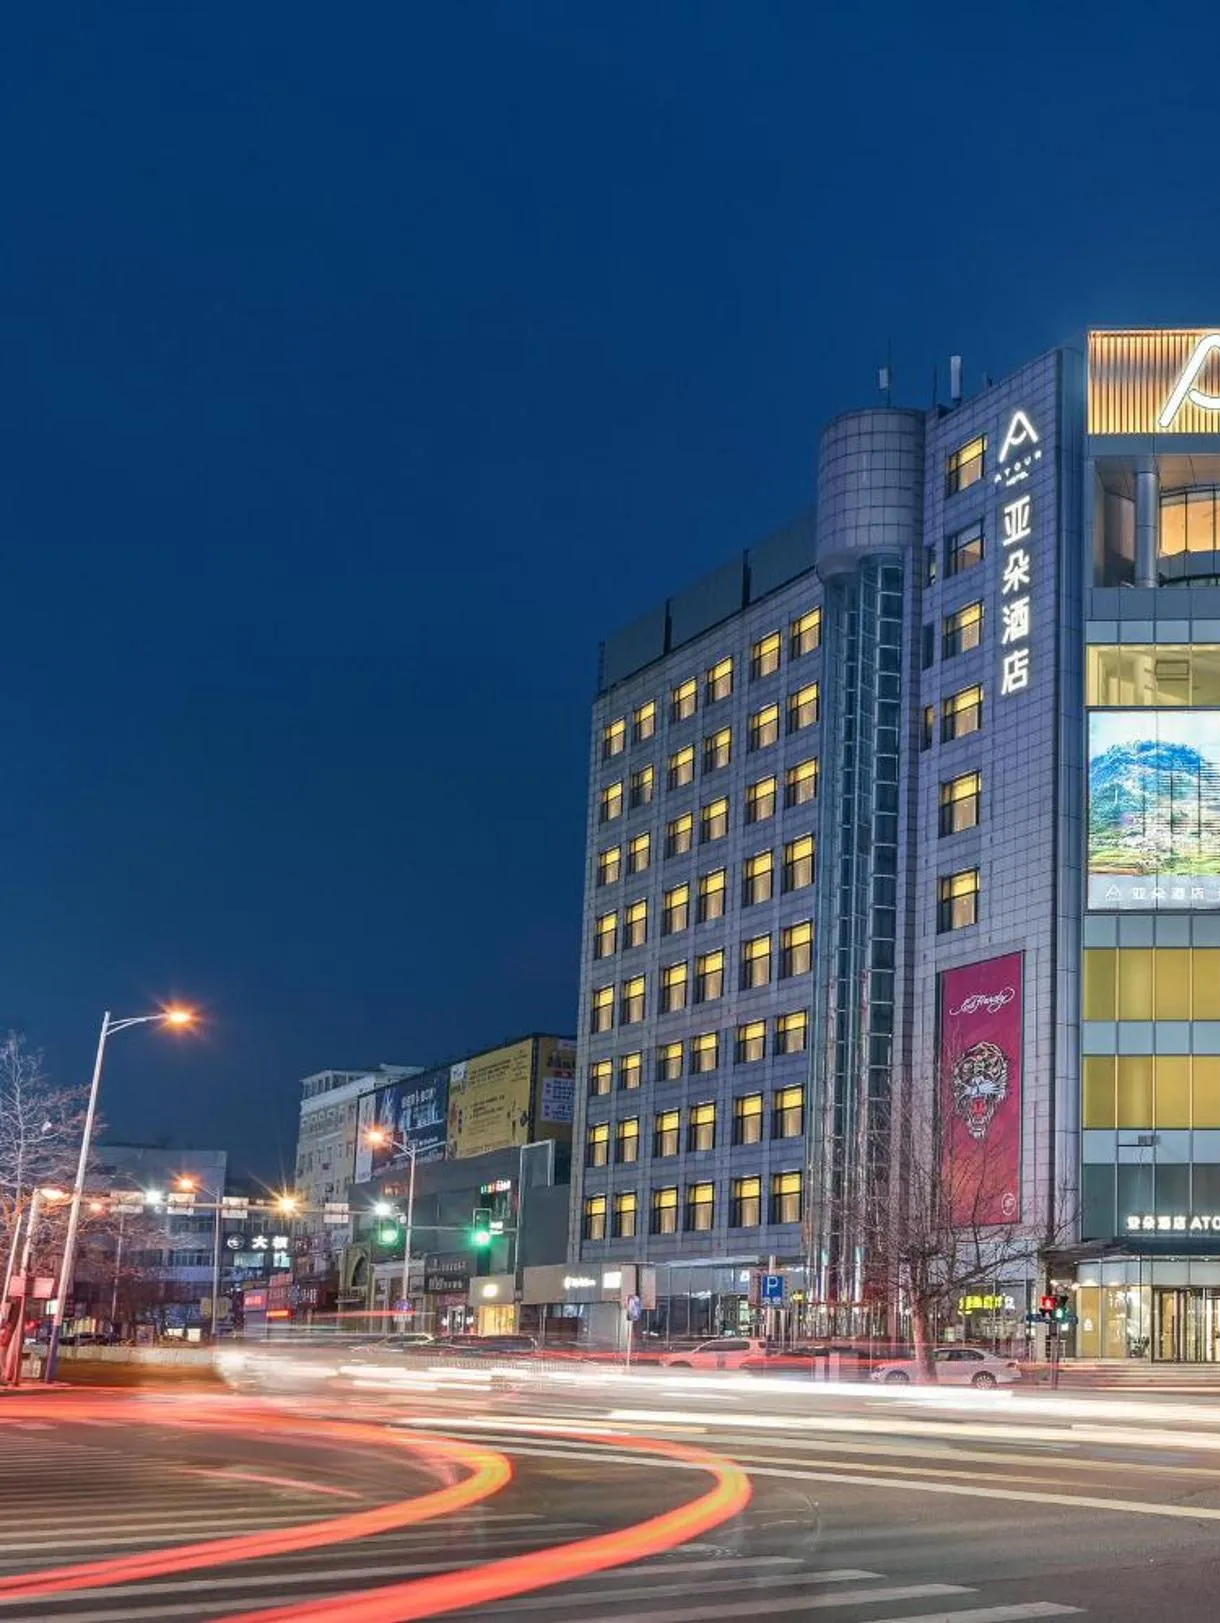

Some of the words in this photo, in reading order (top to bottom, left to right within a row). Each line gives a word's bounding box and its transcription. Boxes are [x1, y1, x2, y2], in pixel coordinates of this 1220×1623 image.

[1002, 496, 1031, 695] 亚朵酒店
[767, 1276, 779, 1296] P
